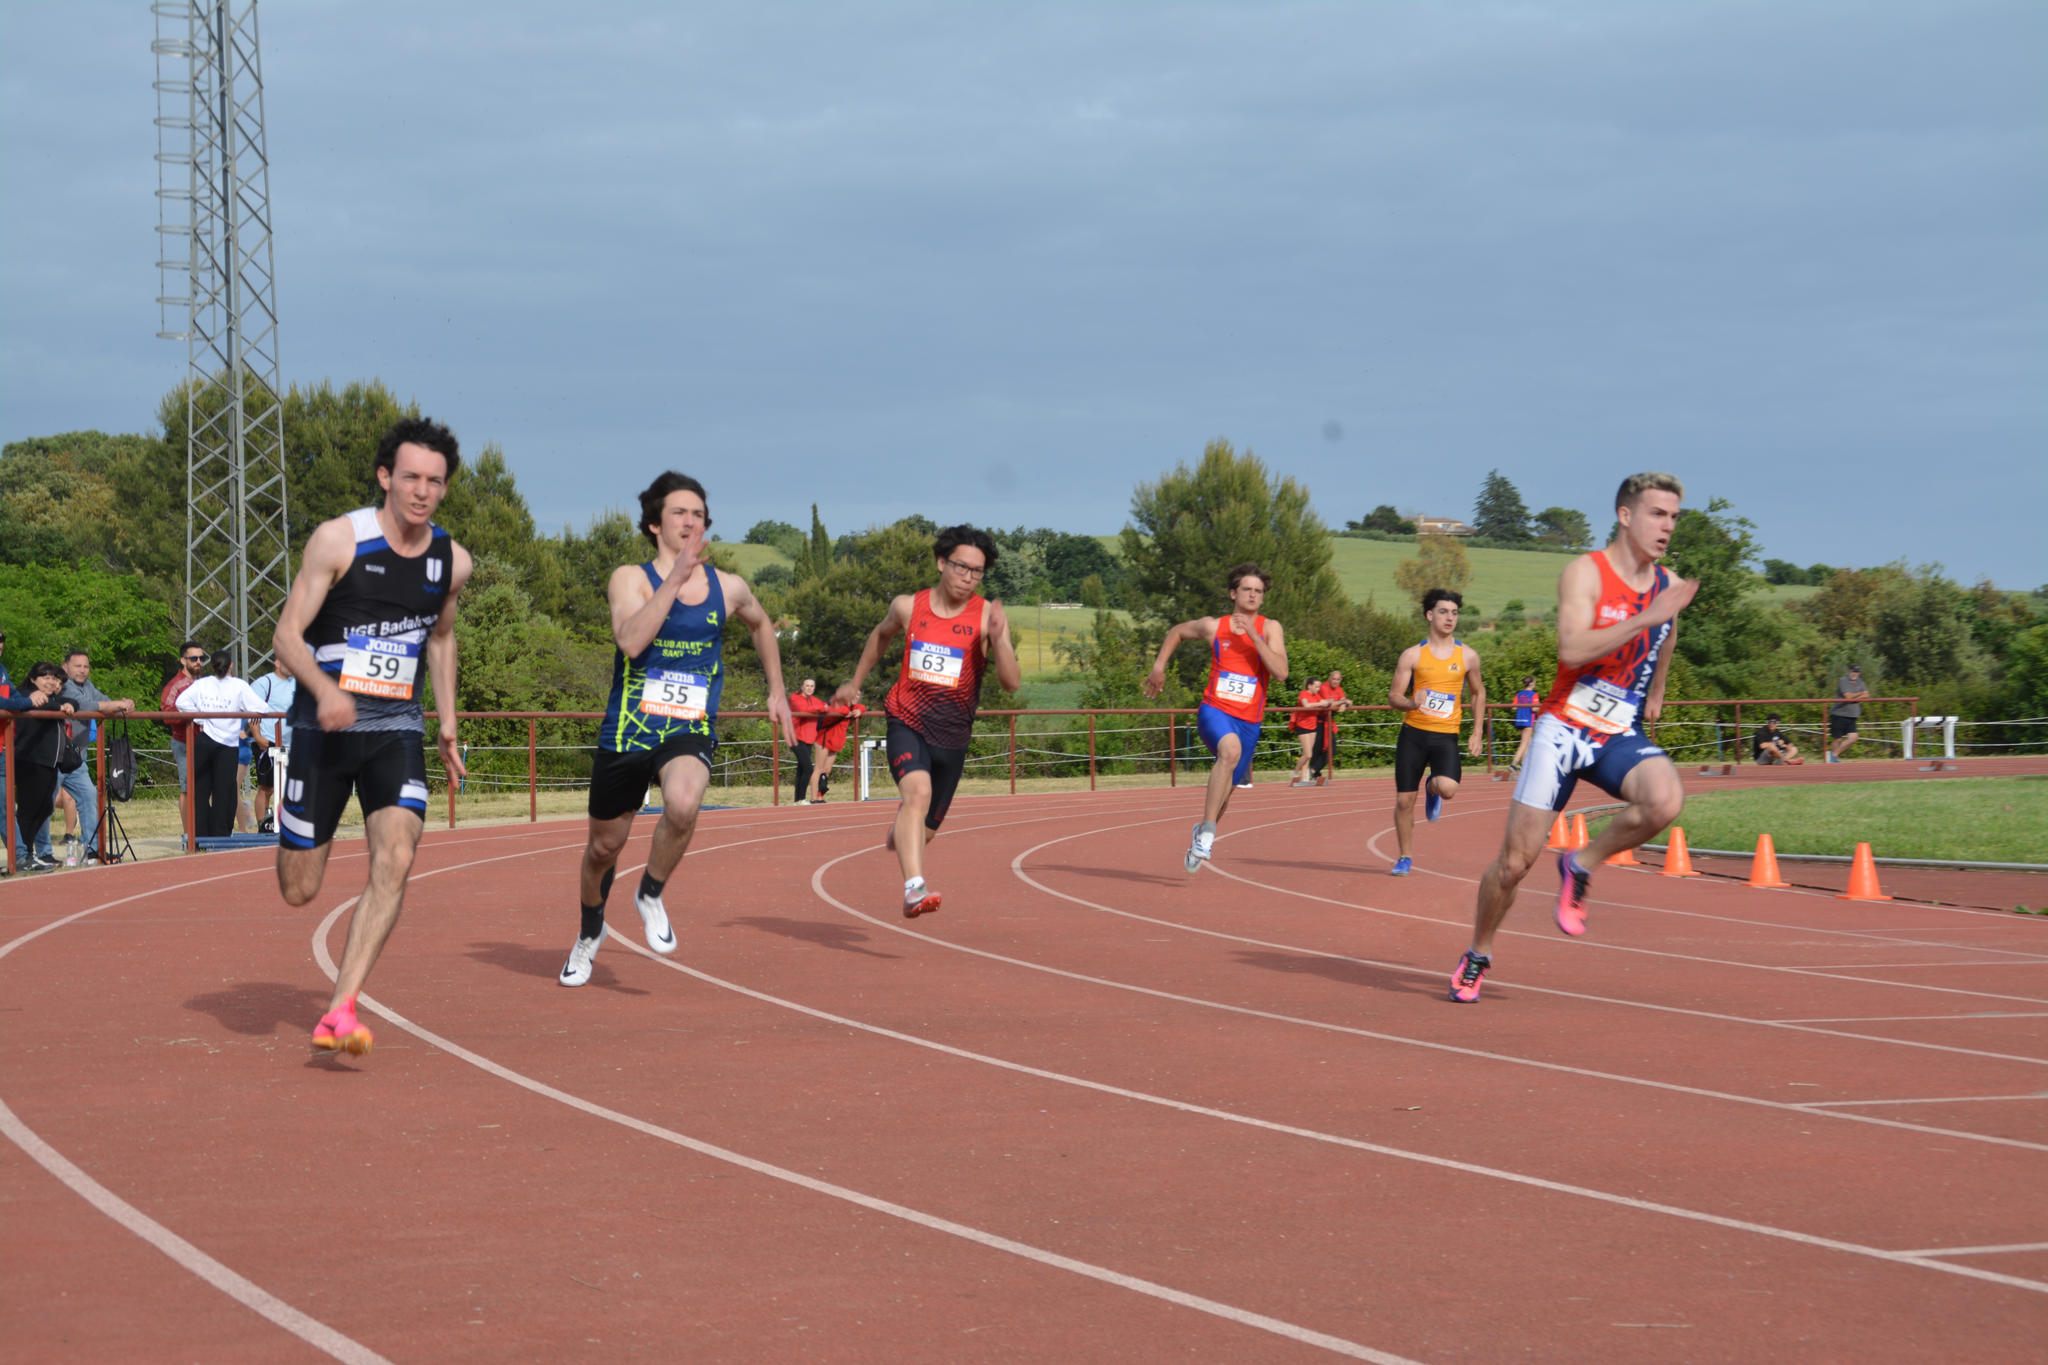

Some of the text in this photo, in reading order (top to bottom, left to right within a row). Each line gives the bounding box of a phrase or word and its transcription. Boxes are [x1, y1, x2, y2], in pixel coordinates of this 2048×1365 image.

[366, 655, 400, 680] 59
[922, 654, 945, 673] 63
[345, 678, 409, 698] mutuacat
[661, 683, 689, 705] 55
[1227, 680, 1245, 695] 53
[644, 702, 702, 720] mutuacat
[1428, 698, 1446, 711] 67
[1587, 693, 1619, 718] 57
